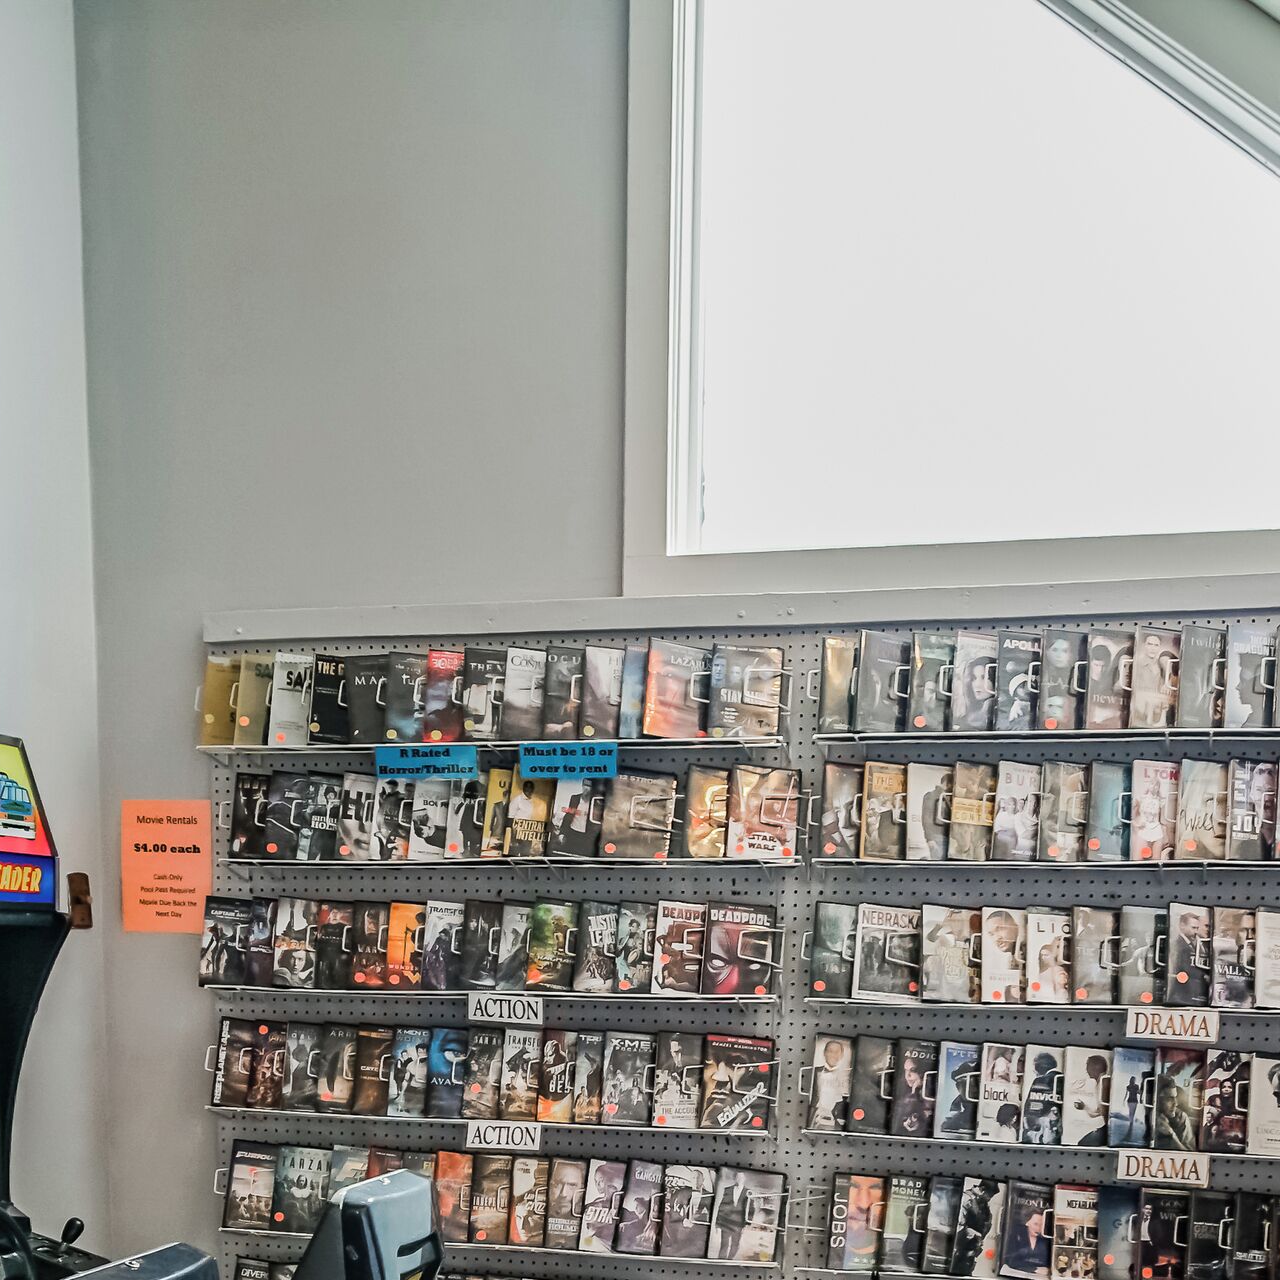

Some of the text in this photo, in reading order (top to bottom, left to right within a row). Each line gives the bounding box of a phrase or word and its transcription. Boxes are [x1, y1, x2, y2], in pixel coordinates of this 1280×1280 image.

[1003, 638, 1041, 652] APOLL
[399, 748, 451, 758] R Rated
[523, 747, 614, 757] Must be 18 or
[379, 764, 474, 775] Horror/Thriller
[529, 765, 608, 774] over to rent
[136, 816, 198, 825] Movie Rentals
[512, 819, 546, 833] CENTRAL
[133, 843, 201, 854] $4.00 each
[748, 843, 776, 851] WARS
[710, 909, 770, 925] DEADPOOL
[861, 909, 920, 930] NEBRASKA
[473, 999, 539, 1020] ACTION
[1135, 1011, 1210, 1037] DRAMA
[732, 1044, 768, 1053] WASHINGTON
[984, 1086, 1009, 1102] black
[471, 1125, 537, 1146] ACTION
[1125, 1155, 1201, 1181] DRAMA
[892, 1178, 922, 1188] BRAD
[830, 1192, 848, 1249] JOBS
